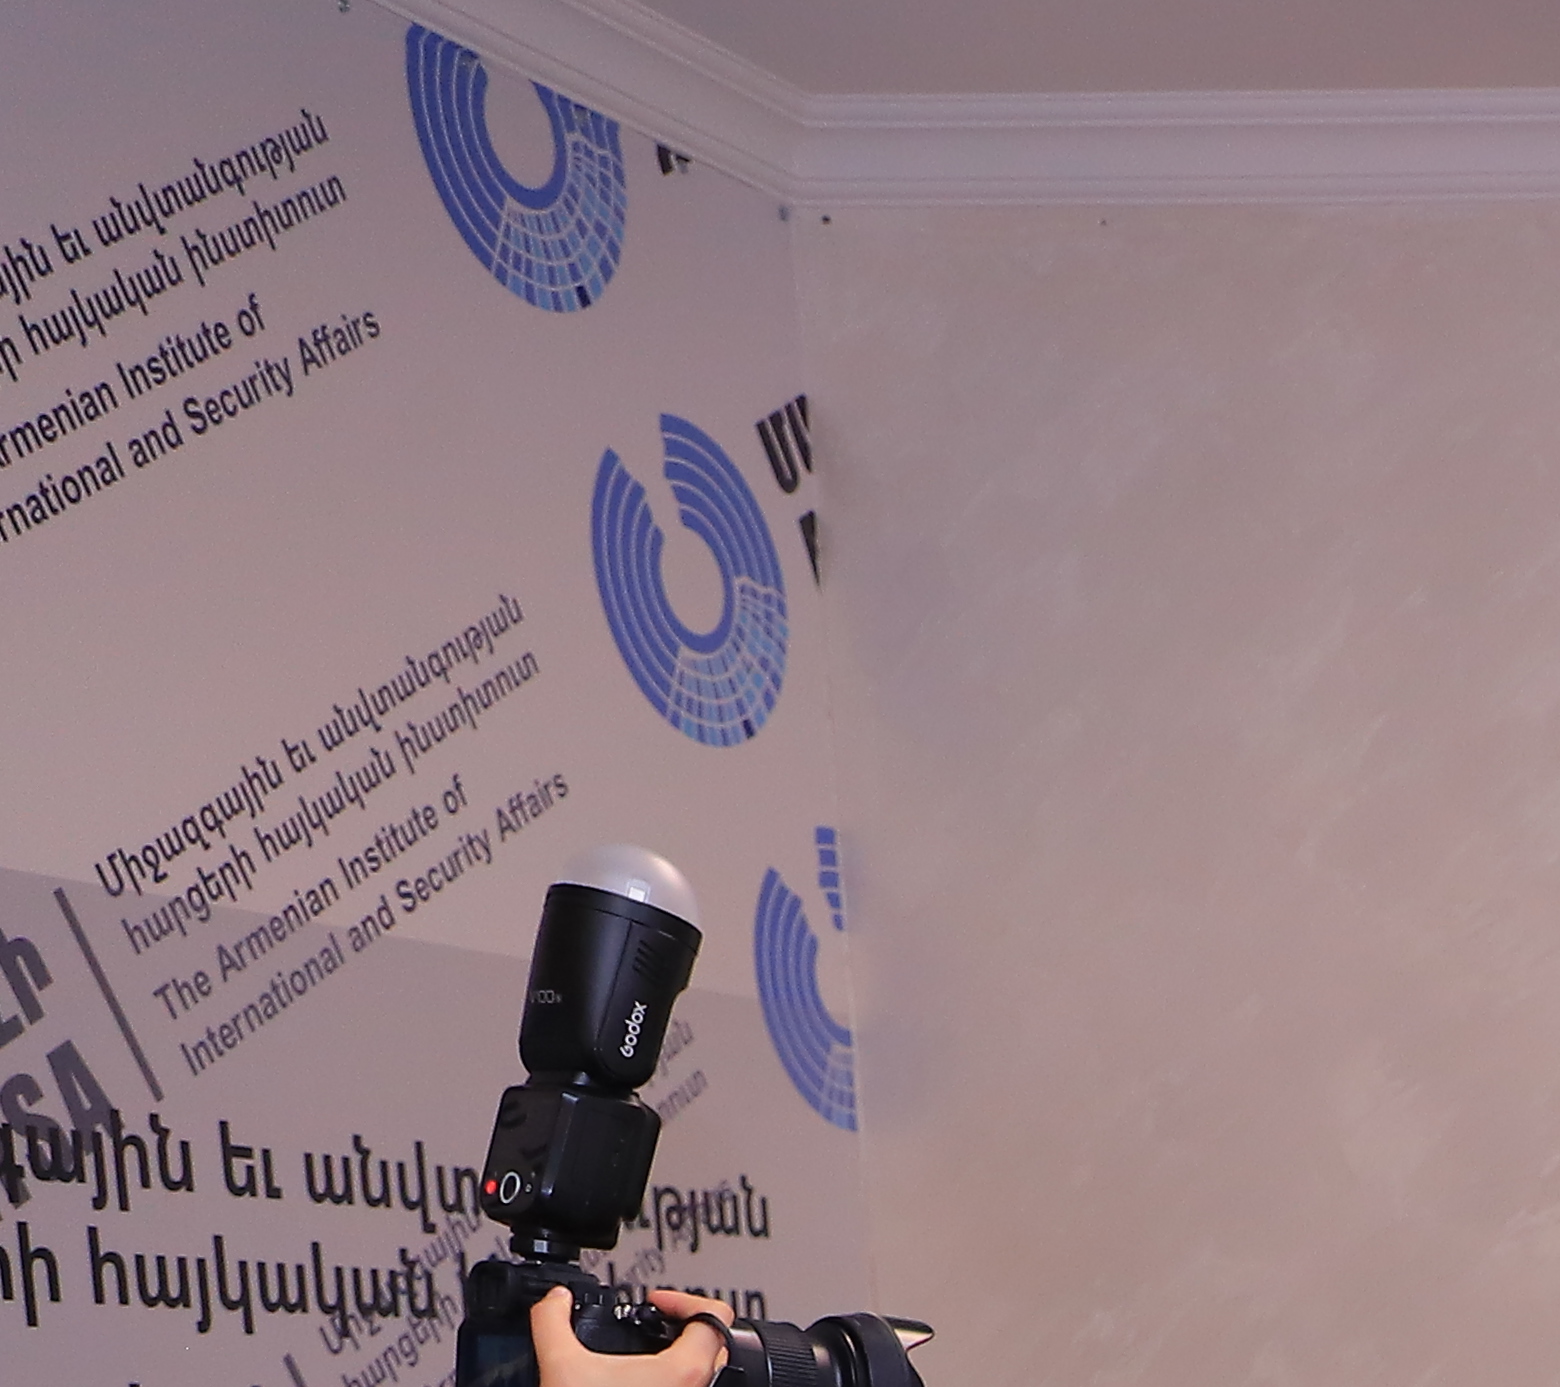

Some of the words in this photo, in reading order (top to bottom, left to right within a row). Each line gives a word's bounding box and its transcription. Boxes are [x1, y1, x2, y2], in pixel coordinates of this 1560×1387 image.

[19, 249, 184, 355] հայկական
[117, 320, 231, 400] Institute
[238, 293, 267, 338] of
[0, 442, 125, 543] rnational
[128, 409, 185, 469] and
[182, 357, 294, 437] Security
[297, 310, 381, 376] Affairs
[154, 966, 212, 1022] The
[216, 873, 340, 983] Armenian
[338, 801, 440, 893] Institute
[443, 773, 469, 819] of
[180, 932, 346, 1077] International
[348, 897, 396, 955] and
[396, 826, 495, 915] Security
[495, 773, 570, 842] Affairs
[620, 1001, 647, 1058] Godox
